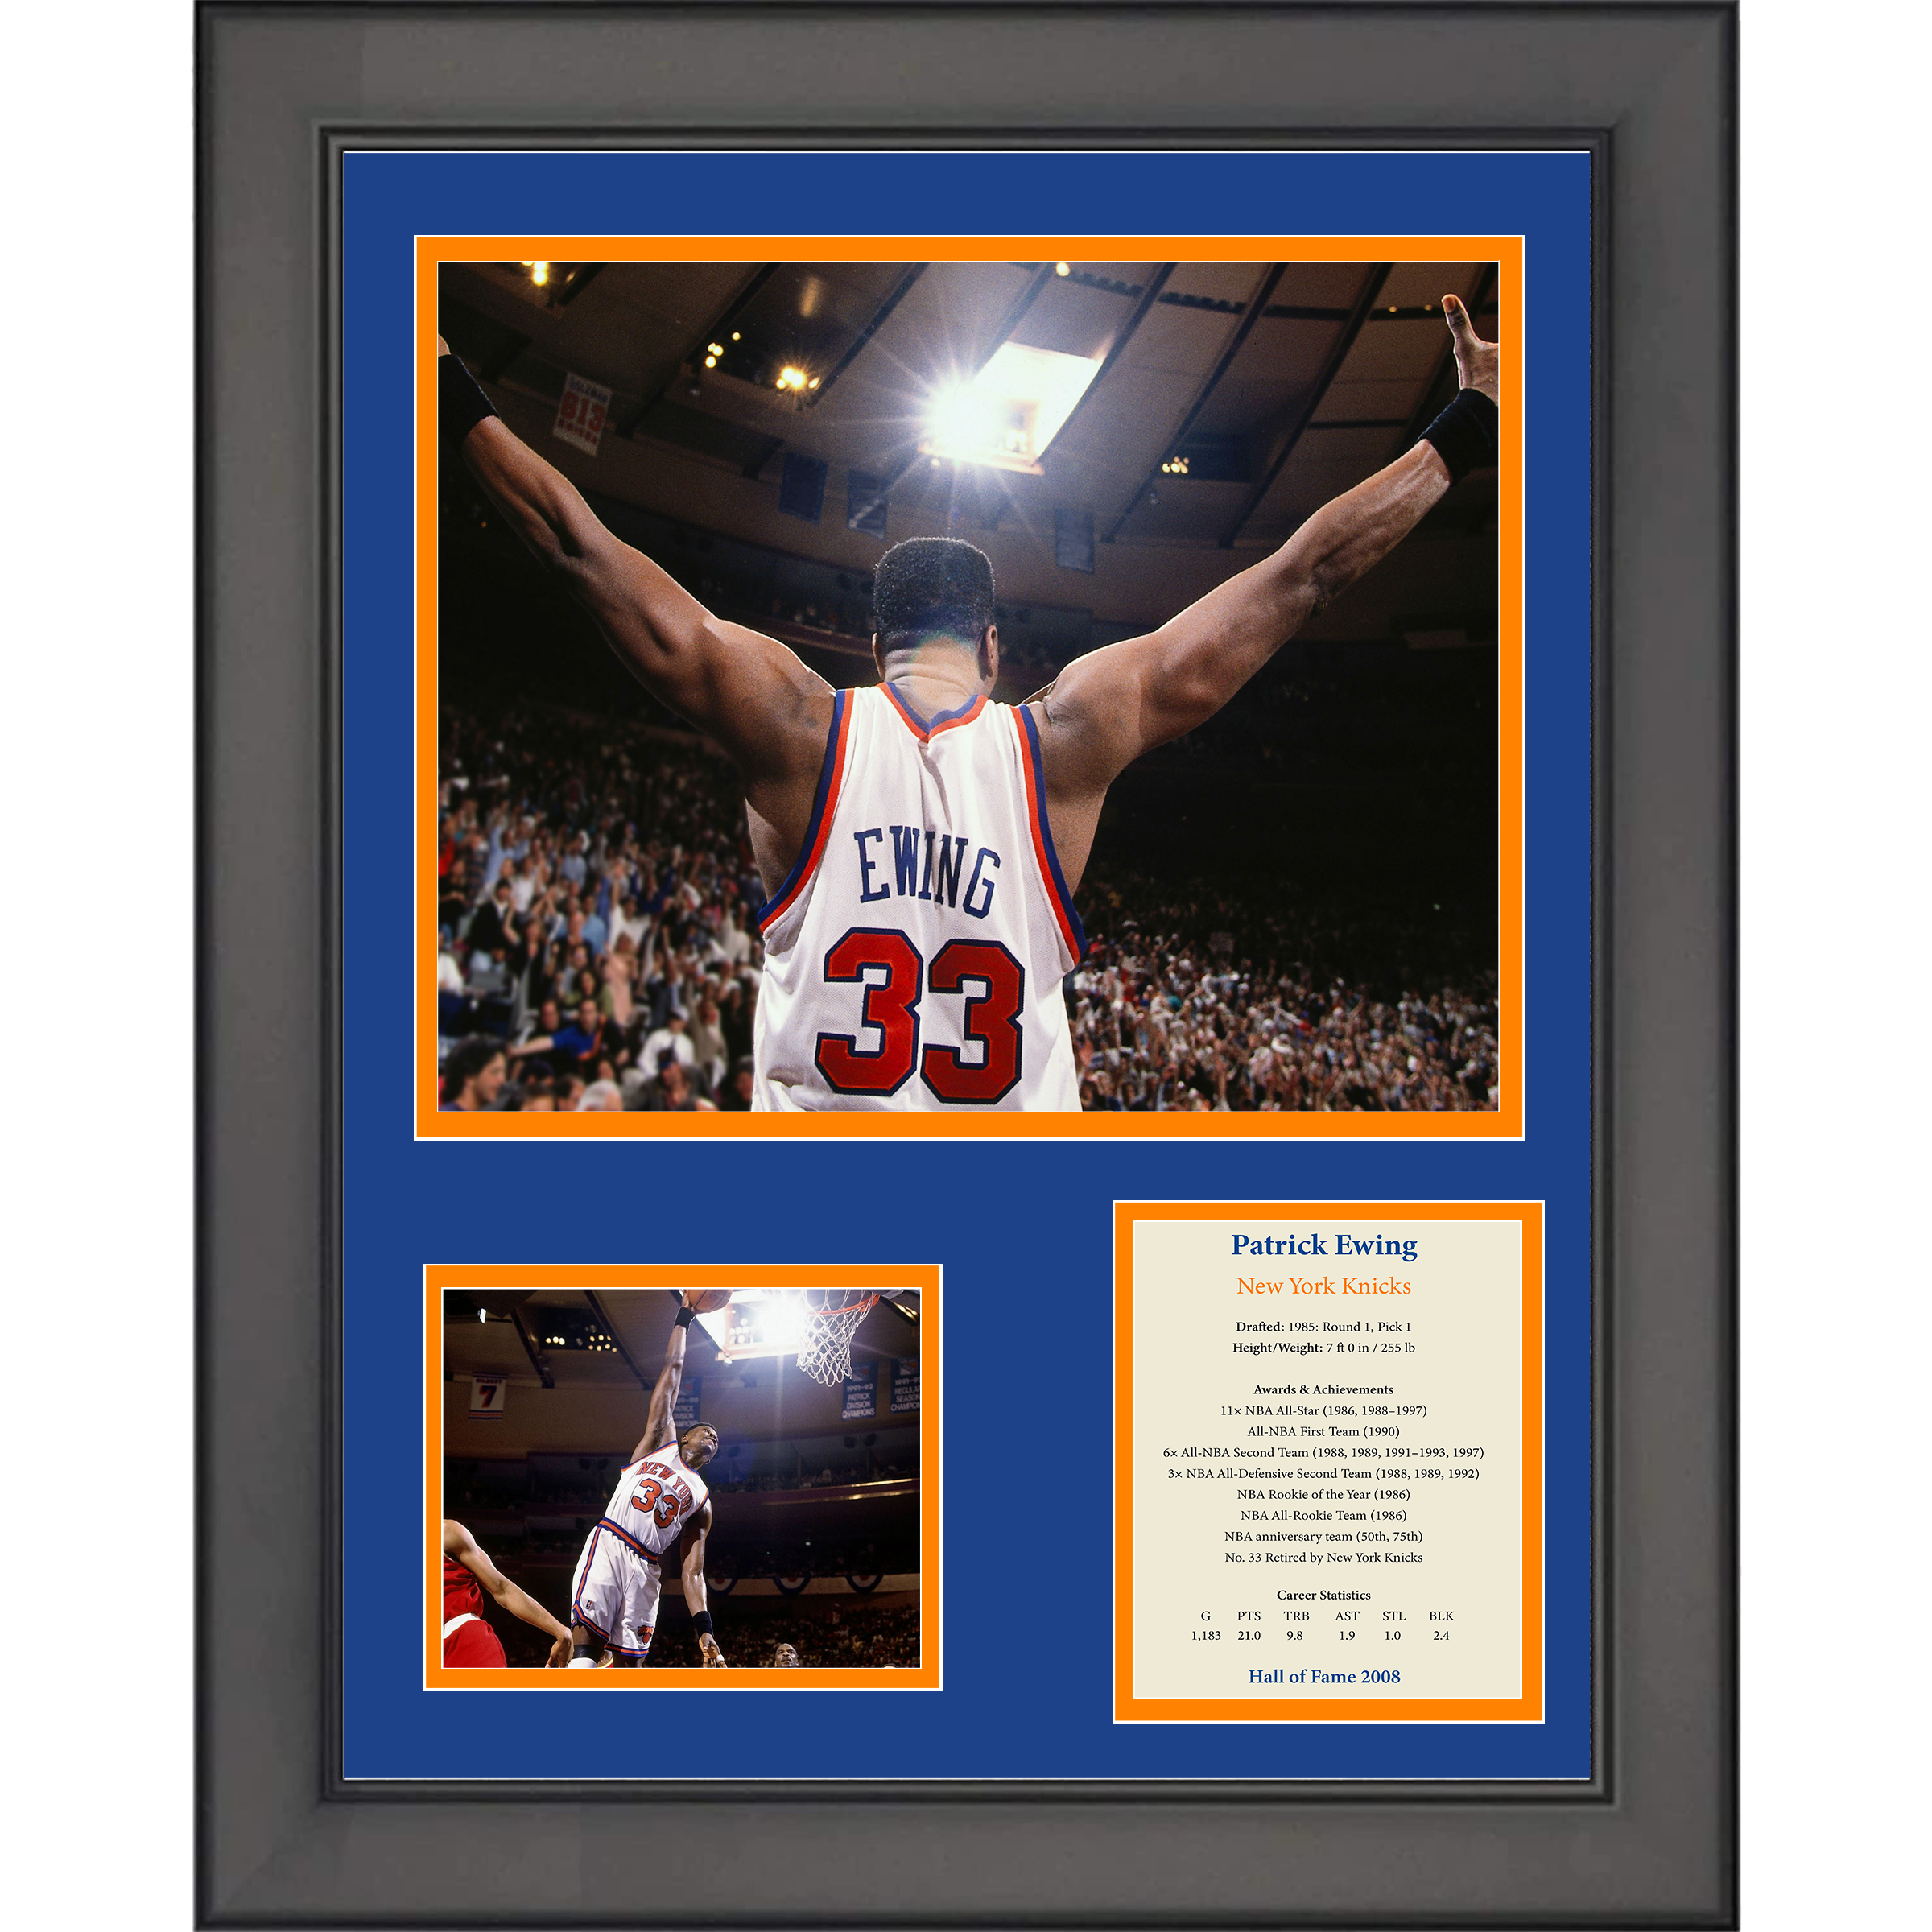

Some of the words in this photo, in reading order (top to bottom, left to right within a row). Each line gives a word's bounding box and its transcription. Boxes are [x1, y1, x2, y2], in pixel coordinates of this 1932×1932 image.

[854, 825, 1001, 919] EWING
[815, 927, 1025, 1105] 33
[1231, 1232, 1329, 1256] Patrick
[1334, 1233, 1418, 1263] Ewing
[1236, 1277, 1285, 1294] New
[1287, 1275, 1336, 1295] York
[1341, 1275, 1412, 1295] Knicks
[1236, 1320, 1285, 1332] Drafted:
[1289, 1321, 1319, 1332] 1985:
[1323, 1321, 1361, 1332] Round
[1364, 1322, 1374, 1333] 1,
[1377, 1321, 1403, 1332] Pick
[1406, 1322, 1411, 1332] 1
[1232, 1342, 1323, 1356] Height/Weight:
[1326, 1343, 1334, 1353] 7
[1336, 1341, 1345, 1353] ft
[1348, 1342, 1355, 1353] 0
[1357, 1342, 1369, 1353] in
[1381, 1343, 1402, 1353] 255
[1404, 1341, 1416, 1353] lb
[479, 1385, 497, 1408] 7
[1253, 1384, 1297, 1395] Awards
[1299, 1384, 1311, 1395] &
[1311, 1384, 1394, 1395] Achievements
[1245, 1405, 1274, 1416] NBA
[1275, 1405, 1320, 1416] All-Star
[1323, 1404, 1358, 1418] (1986,
[1247, 1426, 1298, 1437] All-NBA
[1300, 1426, 1326, 1437] First
[1328, 1426, 1360, 1437] Team
[1363, 1425, 1400, 1439] (1990)
[1180, 1447, 1231, 1458] All-NBA
[1232, 1447, 1275, 1458] Second
[1277, 1447, 1309, 1458] Team
[1312, 1447, 1348, 1460] (1988,
[1352, 1447, 1381, 1459] 1989,
[1453, 1447, 1484, 1460] 1997)
[1186, 1468, 1215, 1479] NBA
[1216, 1468, 1294, 1479] All-Defensive
[1296, 1468, 1338, 1479] Second
[1340, 1468, 1373, 1479] Team
[1375, 1468, 1411, 1481] (1988,
[1414, 1468, 1444, 1480] 1989,
[1448, 1468, 1480, 1481] 1992)
[635, 1461, 676, 1480] NEW
[672, 1476, 693, 1517] YORK
[1236, 1489, 1266, 1500] NBA
[1268, 1488, 1309, 1500] Rookie
[1311, 1488, 1325, 1500] of
[1325, 1488, 1345, 1500] the
[1346, 1489, 1371, 1500] Year
[1373, 1488, 1410, 1502] (1986)
[631, 1478, 680, 1529] 33
[1241, 1510, 1269, 1521] NBA
[1270, 1509, 1333, 1521] All-Rookie
[1335, 1510, 1367, 1521] Team
[1370, 1509, 1407, 1523] (1986)
[1224, 1531, 1253, 1542] NBA
[1255, 1531, 1323, 1545] anniversary
[1325, 1532, 1353, 1542] team
[1356, 1530, 1390, 1544] (50th,
[1393, 1530, 1423, 1544] 75th)
[1224, 1552, 1245, 1563] No.
[1248, 1552, 1262, 1563] 33
[1265, 1551, 1307, 1563] Retired
[1309, 1551, 1324, 1566] by
[1326, 1552, 1353, 1563] New
[1355, 1551, 1381, 1563] York
[1384, 1551, 1423, 1563] Knicks
[1276, 1589, 1318, 1600] Career
[1319, 1589, 1372, 1600] Statistics
[1200, 1610, 1212, 1622] G
[1236, 1610, 1261, 1622] PTS
[1283, 1611, 1310, 1621] TRB
[1335, 1610, 1360, 1622] AST
[1382, 1610, 1406, 1622] STL
[1429, 1611, 1455, 1621] BLK
[1191, 1630, 1222, 1642] 1,183
[1237, 1630, 1261, 1641] 21.0
[1286, 1630, 1303, 1641] 9.8
[1340, 1630, 1356, 1641] 1.9
[1385, 1630, 1402, 1641] 1.0
[1433, 1630, 1450, 1641] 2.4
[1248, 1668, 1285, 1684] Hall
[1289, 1668, 1308, 1684] of
[1310, 1669, 1356, 1684] Fame
[1360, 1670, 1401, 1684] 2008
